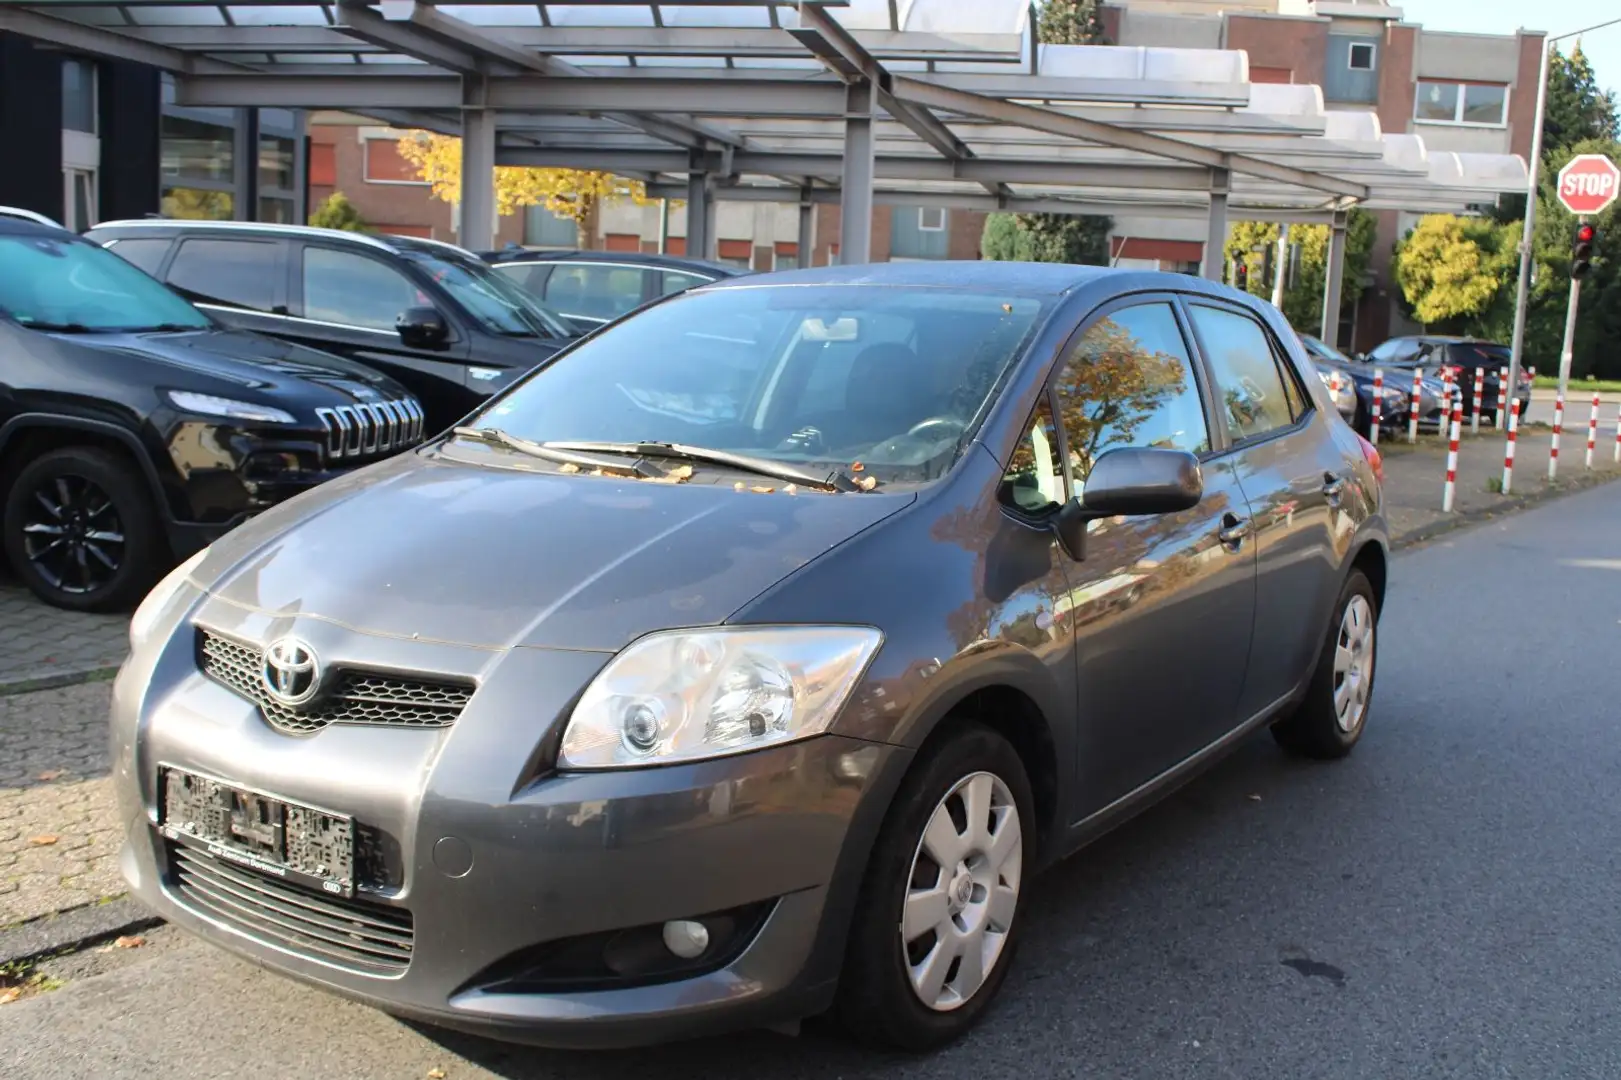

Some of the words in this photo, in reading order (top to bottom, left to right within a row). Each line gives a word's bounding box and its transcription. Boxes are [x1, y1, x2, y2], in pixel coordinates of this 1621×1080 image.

[1564, 173, 1613, 196] STOP
[222, 850, 249, 865] Zentrum
[250, 858, 285, 876] Dortmund
